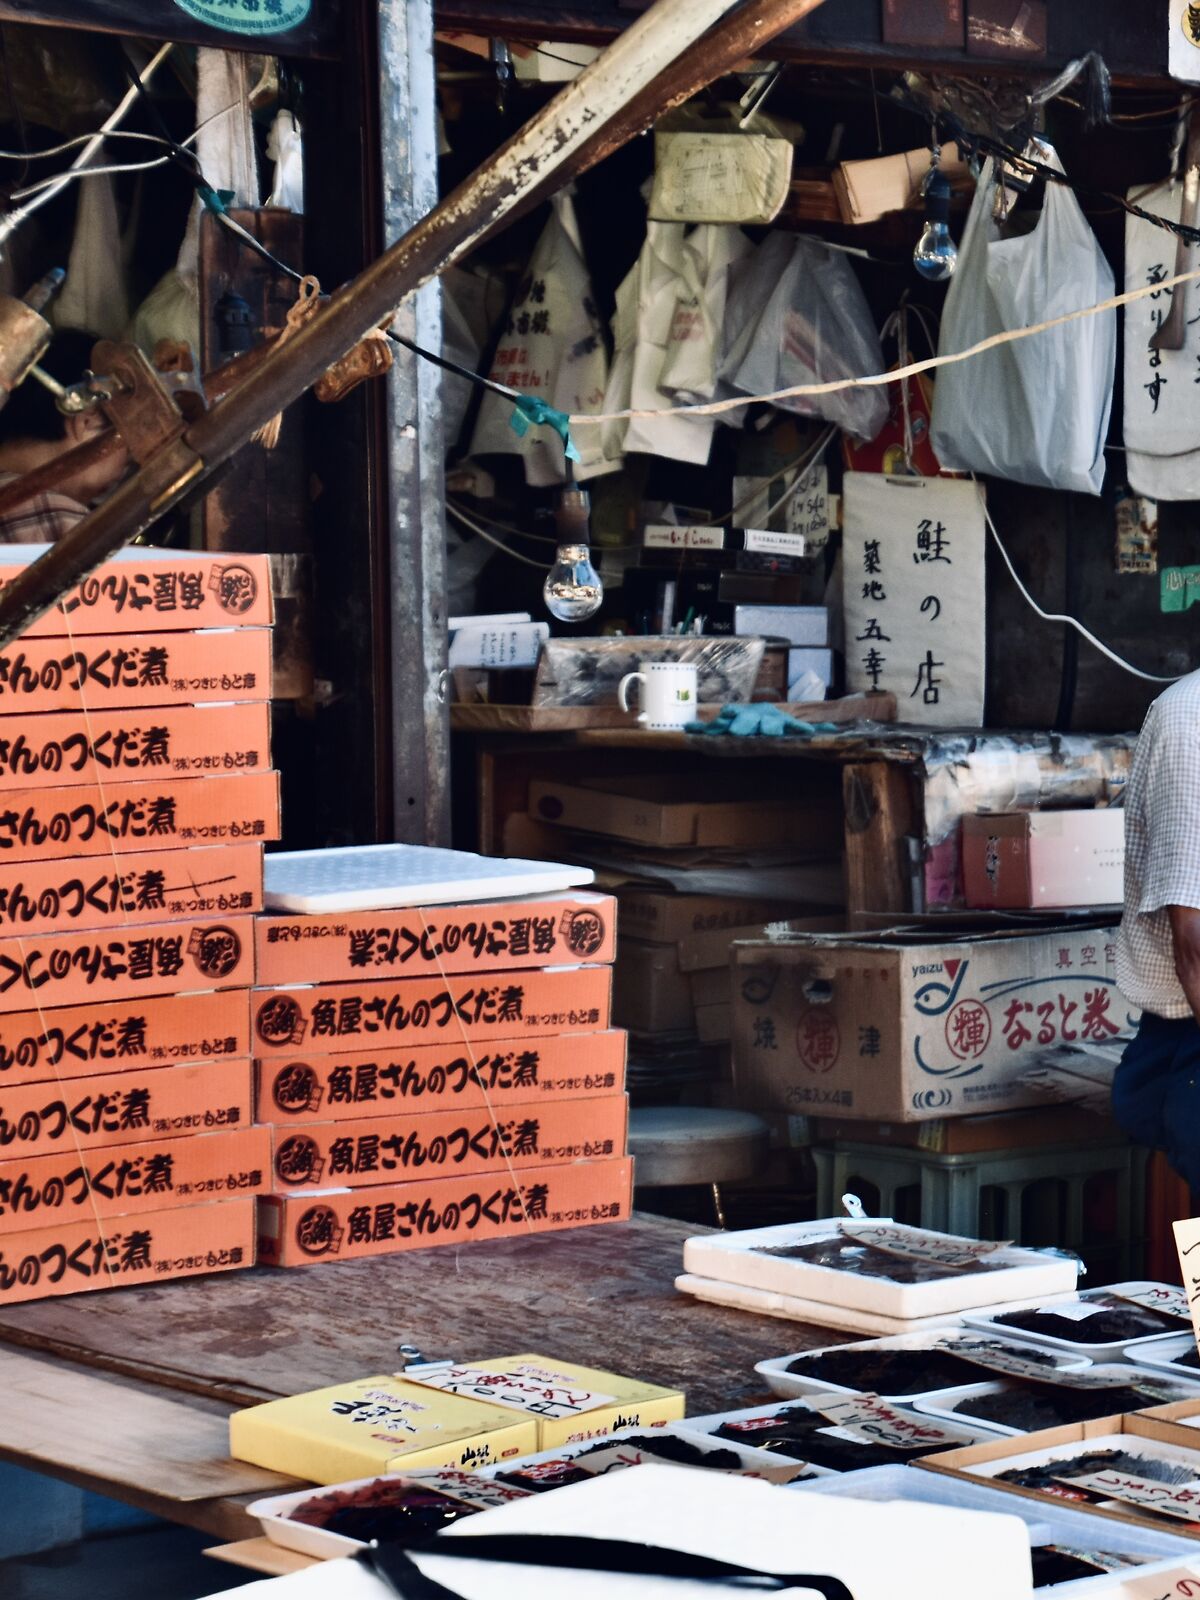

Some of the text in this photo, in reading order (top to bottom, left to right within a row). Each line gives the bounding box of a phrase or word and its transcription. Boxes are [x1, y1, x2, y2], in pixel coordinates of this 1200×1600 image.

[856, 540, 891, 692] 築地五幸
[911, 519, 952, 705] 鮭の店
[349, 916, 556, 968] 魚屋さんのつくだ煮
[912, 961, 943, 977] yaizu
[311, 986, 525, 1036] 魚屋さんのつくだ煮
[1003, 987, 1121, 1050] なると巻
[327, 1051, 539, 1104] 魚屋さんのつくだ煮
[329, 1119, 540, 1176] 魚屋さんのつくだ煮
[347, 1183, 549, 1245] 魚屋さんのつくだ煮
